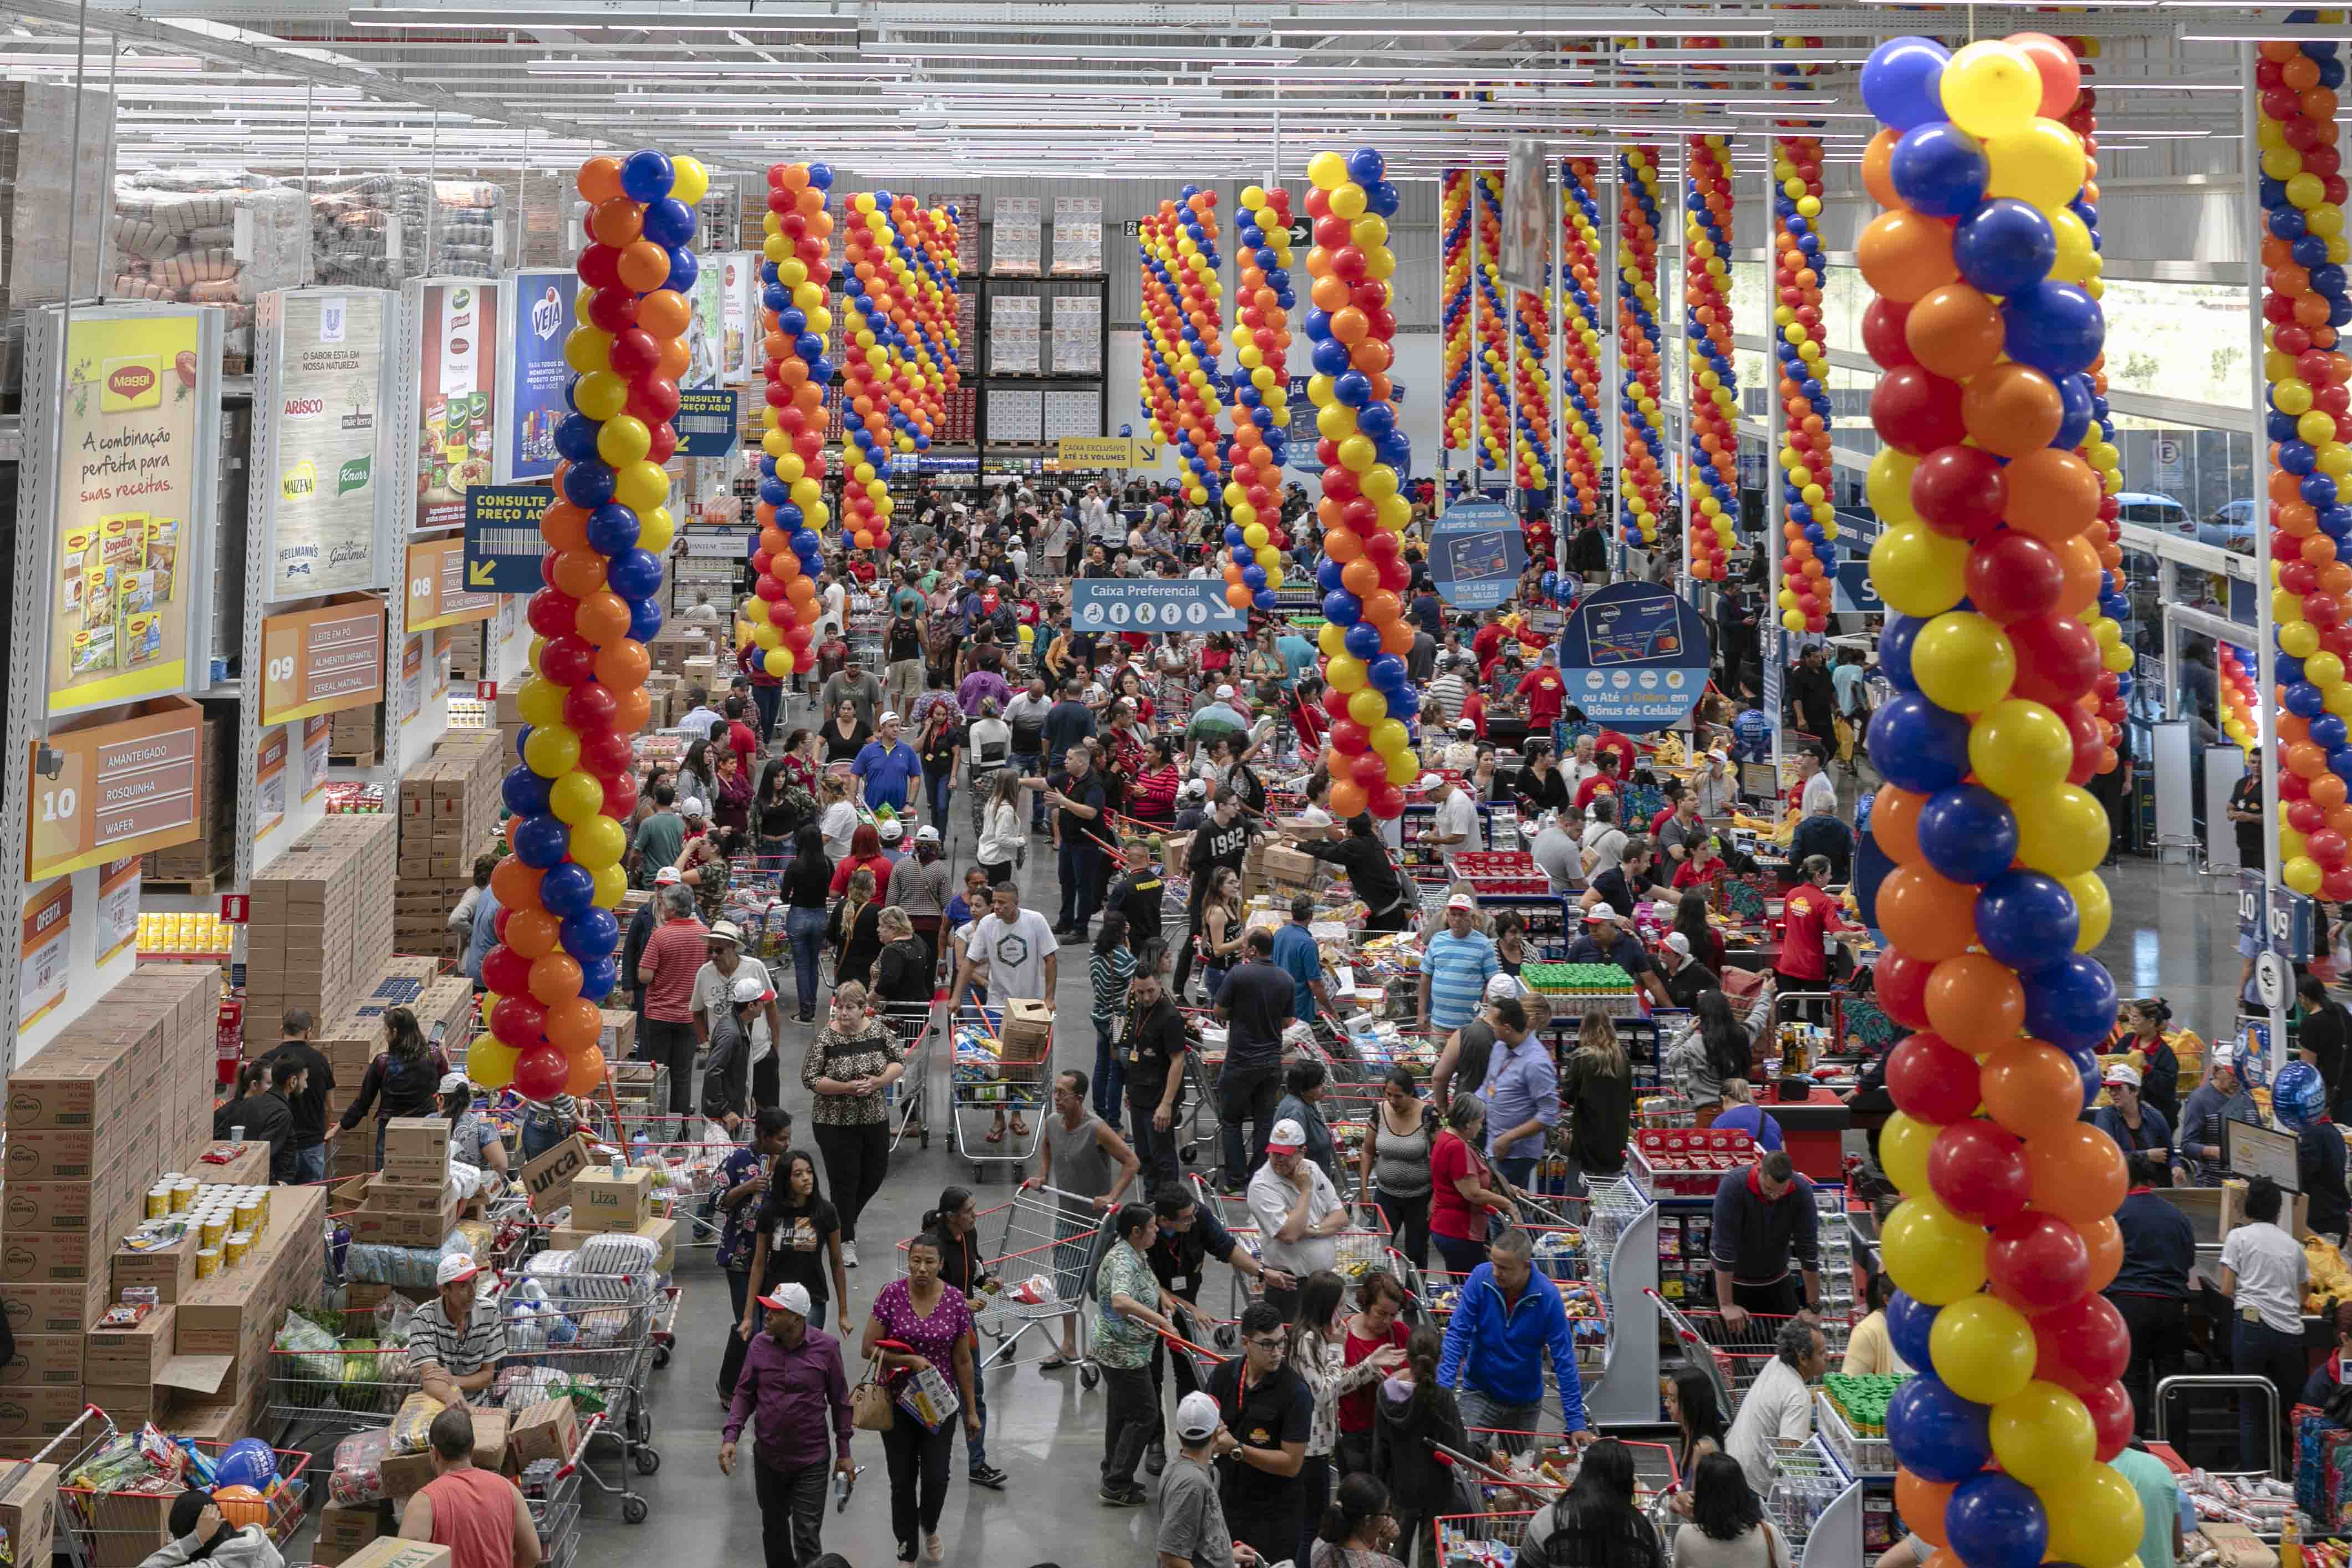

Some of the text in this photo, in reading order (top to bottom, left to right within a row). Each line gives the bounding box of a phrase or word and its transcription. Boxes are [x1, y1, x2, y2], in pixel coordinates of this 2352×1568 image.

[534, 301, 561, 333] VEJA
[303, 349, 360, 360] O SABOR ESTÁ EM
[303, 361, 359, 371] NOSSA NATUREZA
[114, 374, 150, 387] Maggi
[1289, 381, 1304, 396] já
[284, 398, 323, 415] ARISCO
[678, 404, 730, 413] PREÇO AQUI
[83, 425, 171, 452] A combinação
[83, 452, 170, 485] perfeita para
[340, 468, 369, 481] Knorr
[80, 473, 174, 502] suas receitas.
[284, 478, 313, 494] MAIZENA
[476, 496, 547, 507] CONSULTE
[476, 508, 521, 522] PREÇO
[104, 536, 133, 554] Sopão
[279, 543, 319, 562] HELLMANN'S
[689, 542, 719, 550] PANTENE
[328, 544, 368, 568] Gourmet
[1091, 585, 1200, 597] Caixa Preferencial
[314, 627, 351, 642] LEITE EM PÓ
[315, 650, 373, 667] ALIMENTO INFANTIL
[268, 656, 293, 683] 09
[314, 678, 363, 693] CEREAL MATINAL
[1582, 694, 1597, 702] ou
[1600, 692, 1620, 702] Até
[1587, 704, 1623, 715] Bônus
[1625, 705, 1640, 715] de
[107, 745, 167, 768] AMANTEIGADO
[106, 781, 155, 801] ROSQUINHA
[42, 787, 76, 822] 10
[105, 818, 134, 834] WAFER
[1210, 826, 1245, 857] 1992
[2238, 889, 2255, 921] 10
[37, 901, 61, 931] OFERTA
[2271, 907, 2289, 940] 09
[531, 1149, 580, 1194] urca
[589, 1190, 618, 1206] Liza
